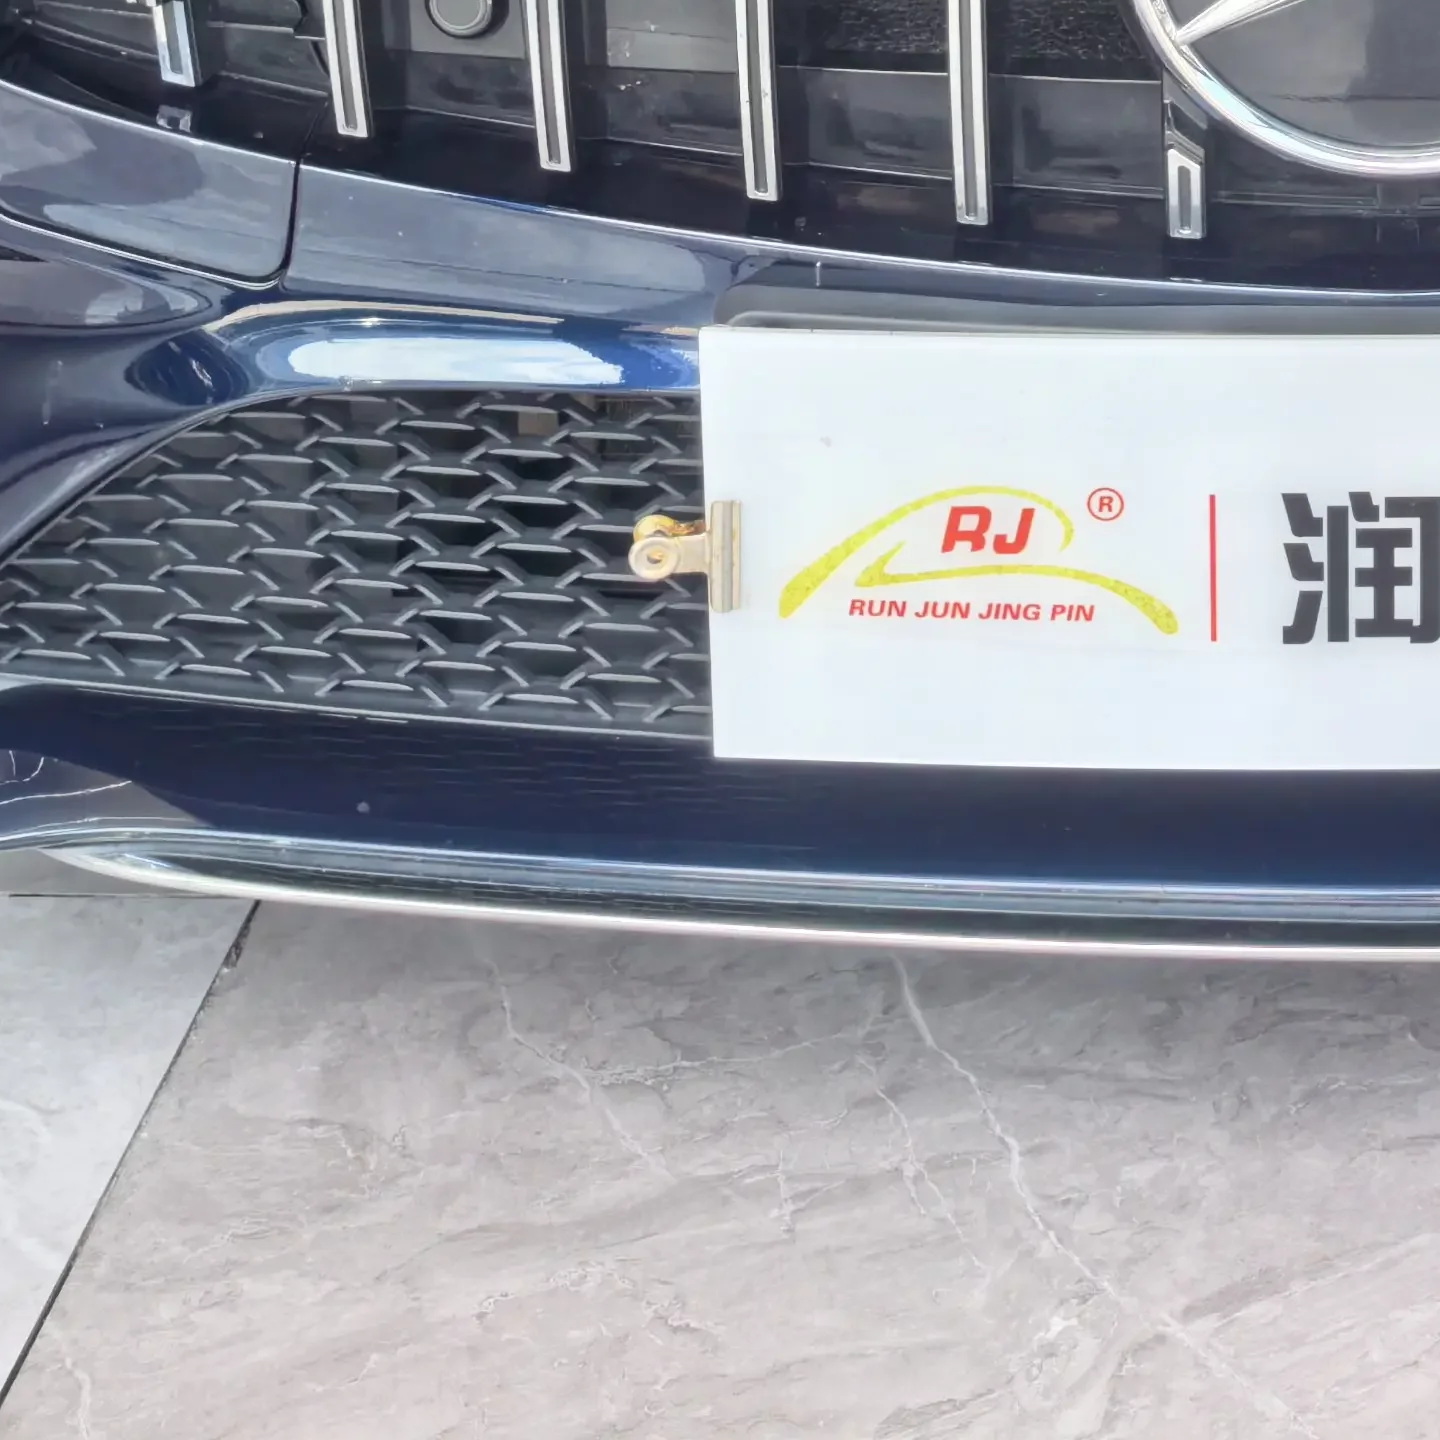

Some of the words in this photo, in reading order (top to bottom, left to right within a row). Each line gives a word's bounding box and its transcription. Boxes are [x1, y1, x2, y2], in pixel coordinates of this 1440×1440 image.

[940, 505, 1037, 556] RJ
[848, 598, 908, 618] RUN
[915, 600, 972, 621] JUN
[978, 602, 1042, 622] JING
[1049, 603, 1096, 623] PIN
